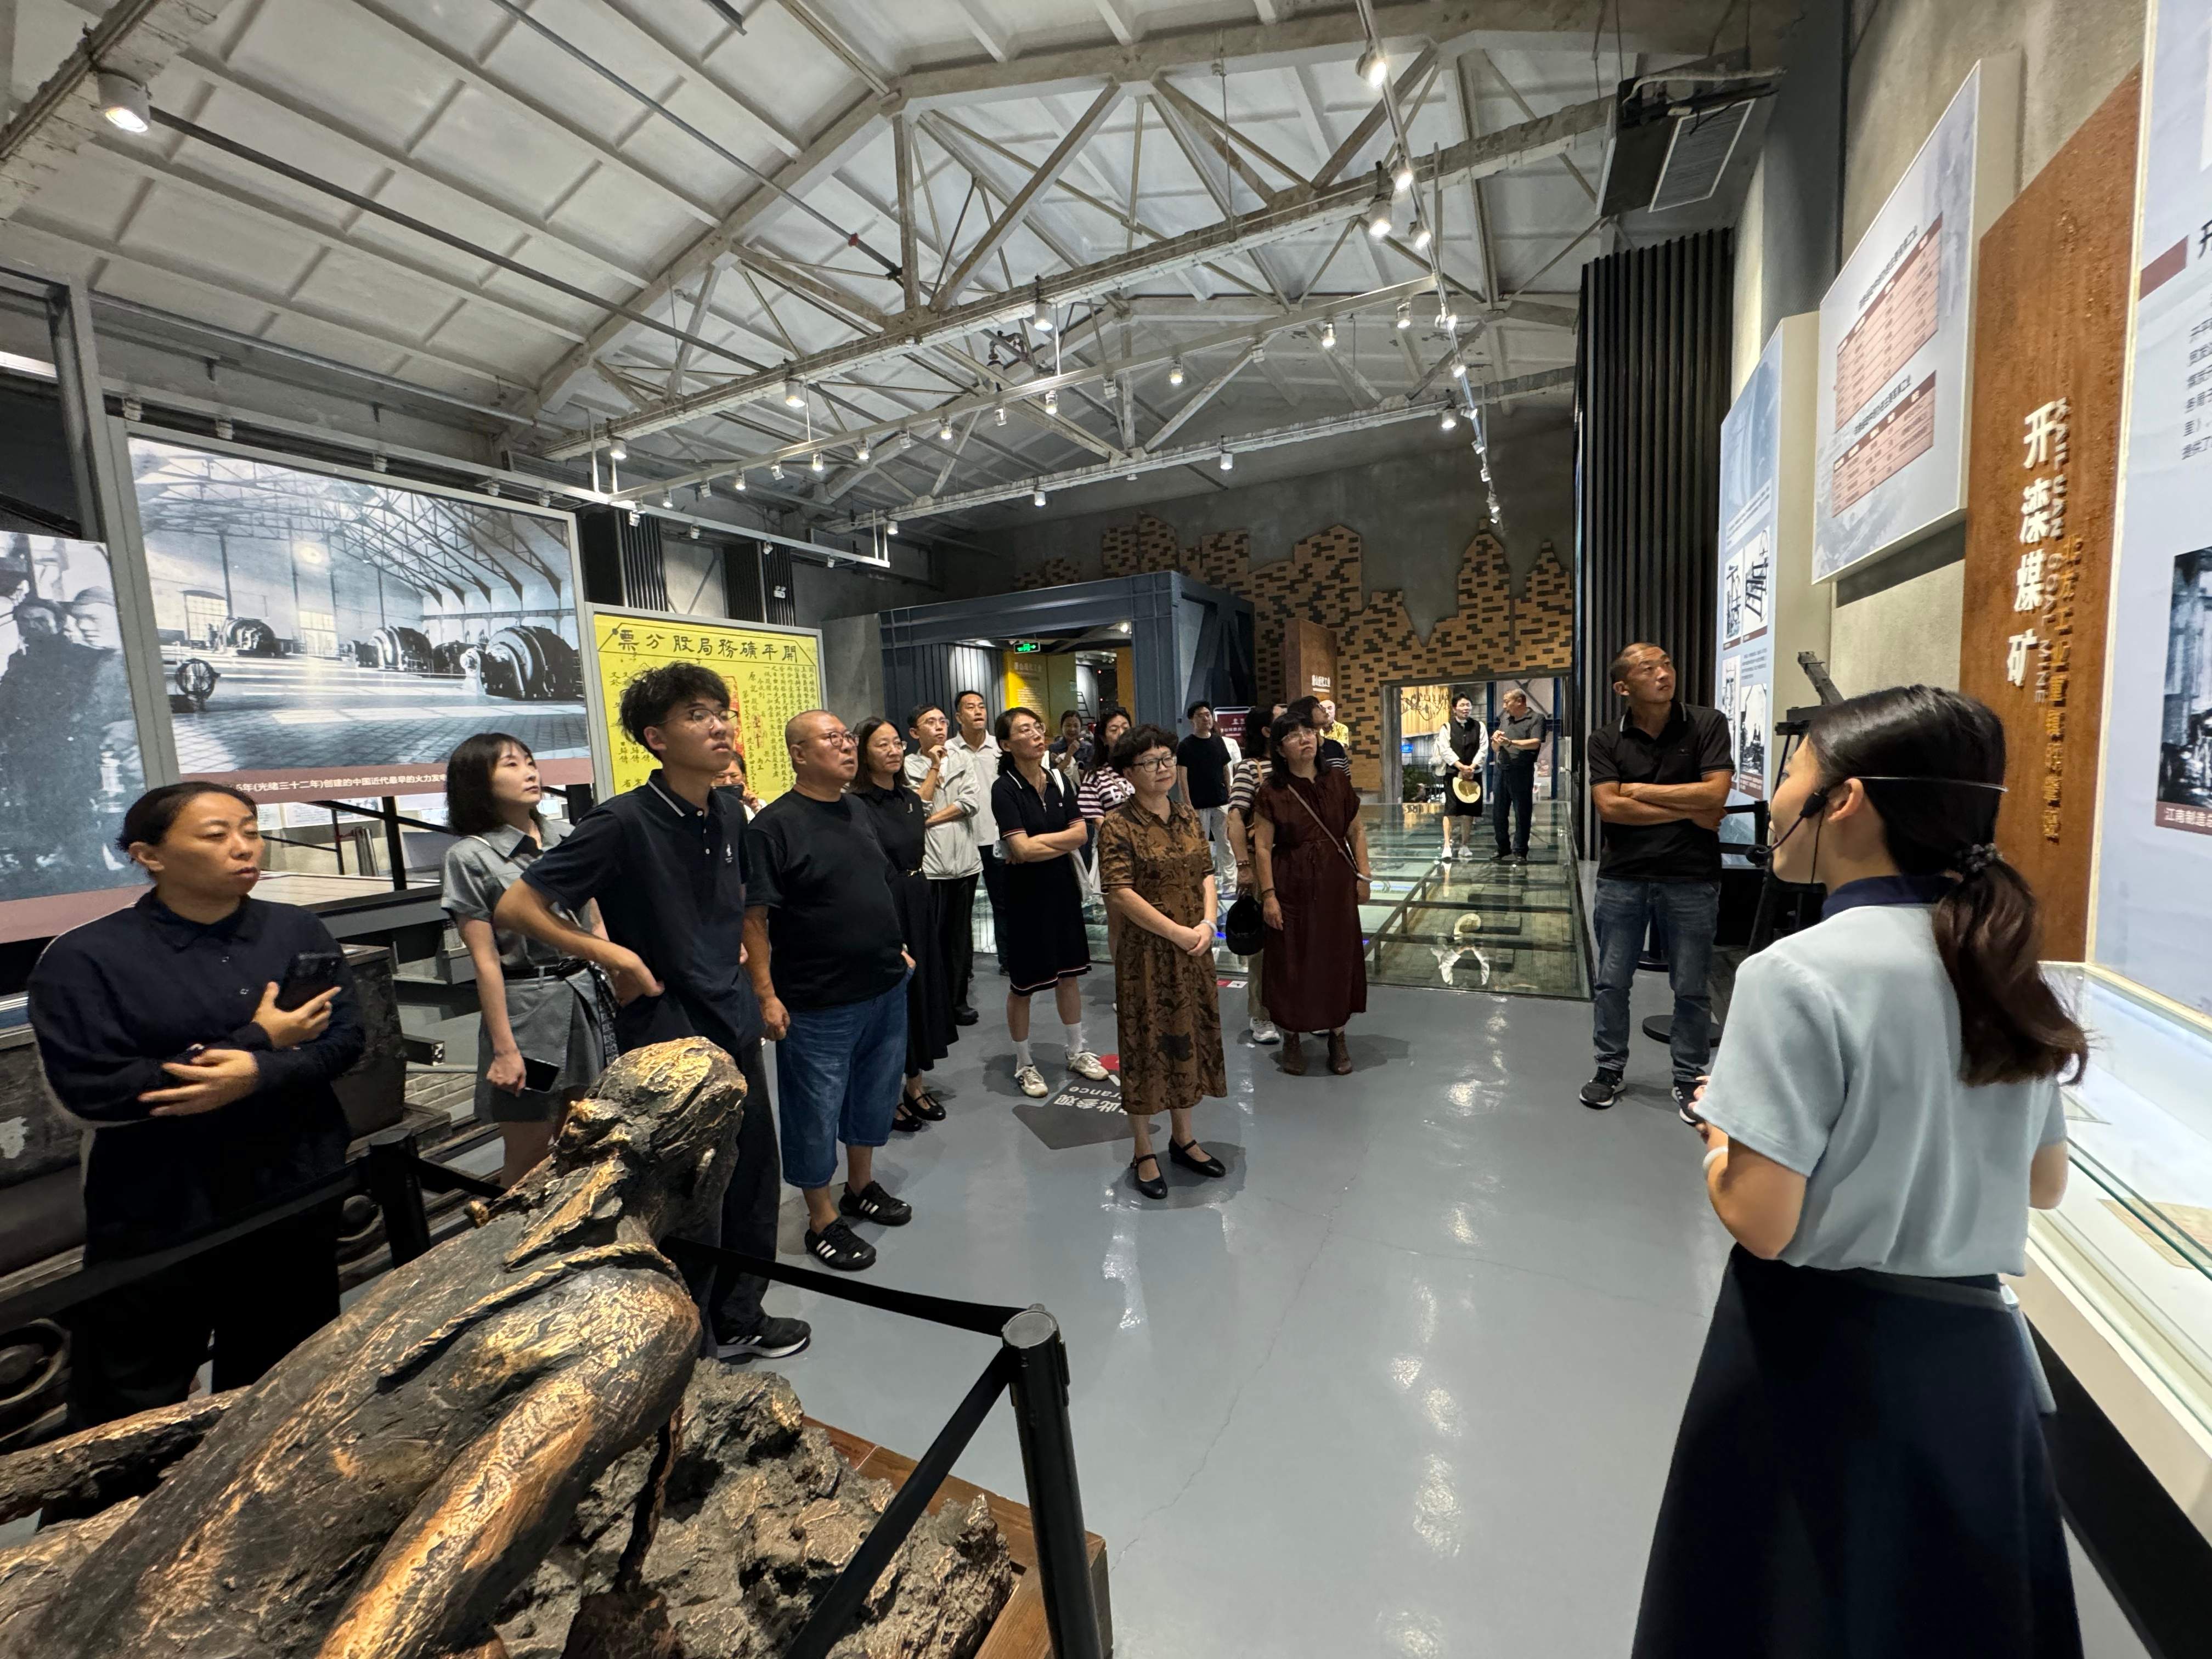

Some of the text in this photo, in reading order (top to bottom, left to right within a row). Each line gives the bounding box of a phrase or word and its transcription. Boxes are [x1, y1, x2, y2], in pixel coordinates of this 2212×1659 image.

[2007, 400, 2057, 687] 开滦煤矿
[1069, 1086, 1122, 1099] rance
